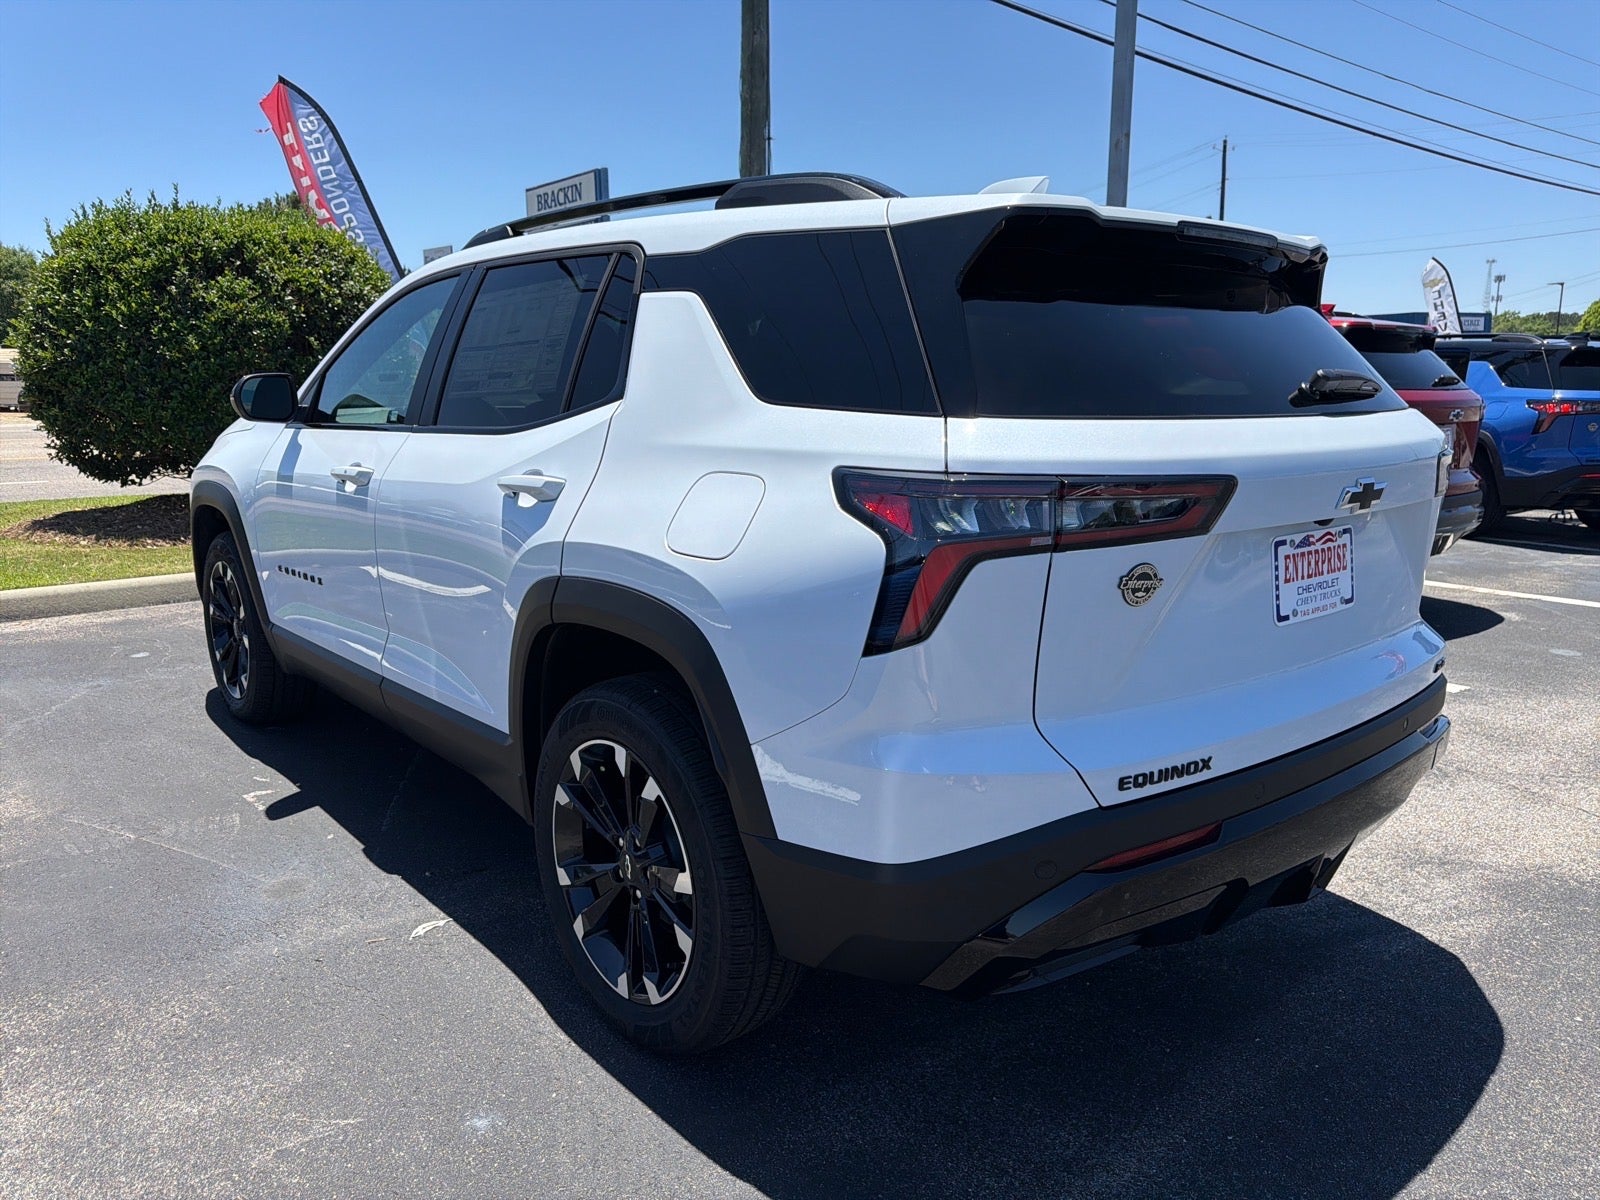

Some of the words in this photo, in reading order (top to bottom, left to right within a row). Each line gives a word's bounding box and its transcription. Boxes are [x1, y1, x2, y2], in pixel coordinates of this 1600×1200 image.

[536, 182, 582, 212] BRACKIN
[1284, 544, 1347, 584] ENTERPRISE
[277, 564, 324, 586] EQUINOX
[1120, 576, 1164, 591] Enterprise
[1297, 578, 1339, 595] CHEVROLET
[1296, 593, 1318, 606] CHEVY
[1319, 589, 1341, 601] TRUCKS
[1300, 609, 1310, 617] TAG
[1311, 605, 1328, 615] APPLIED
[1329, 602, 1337, 610] FOR
[1118, 755, 1213, 792] EQUINOX
